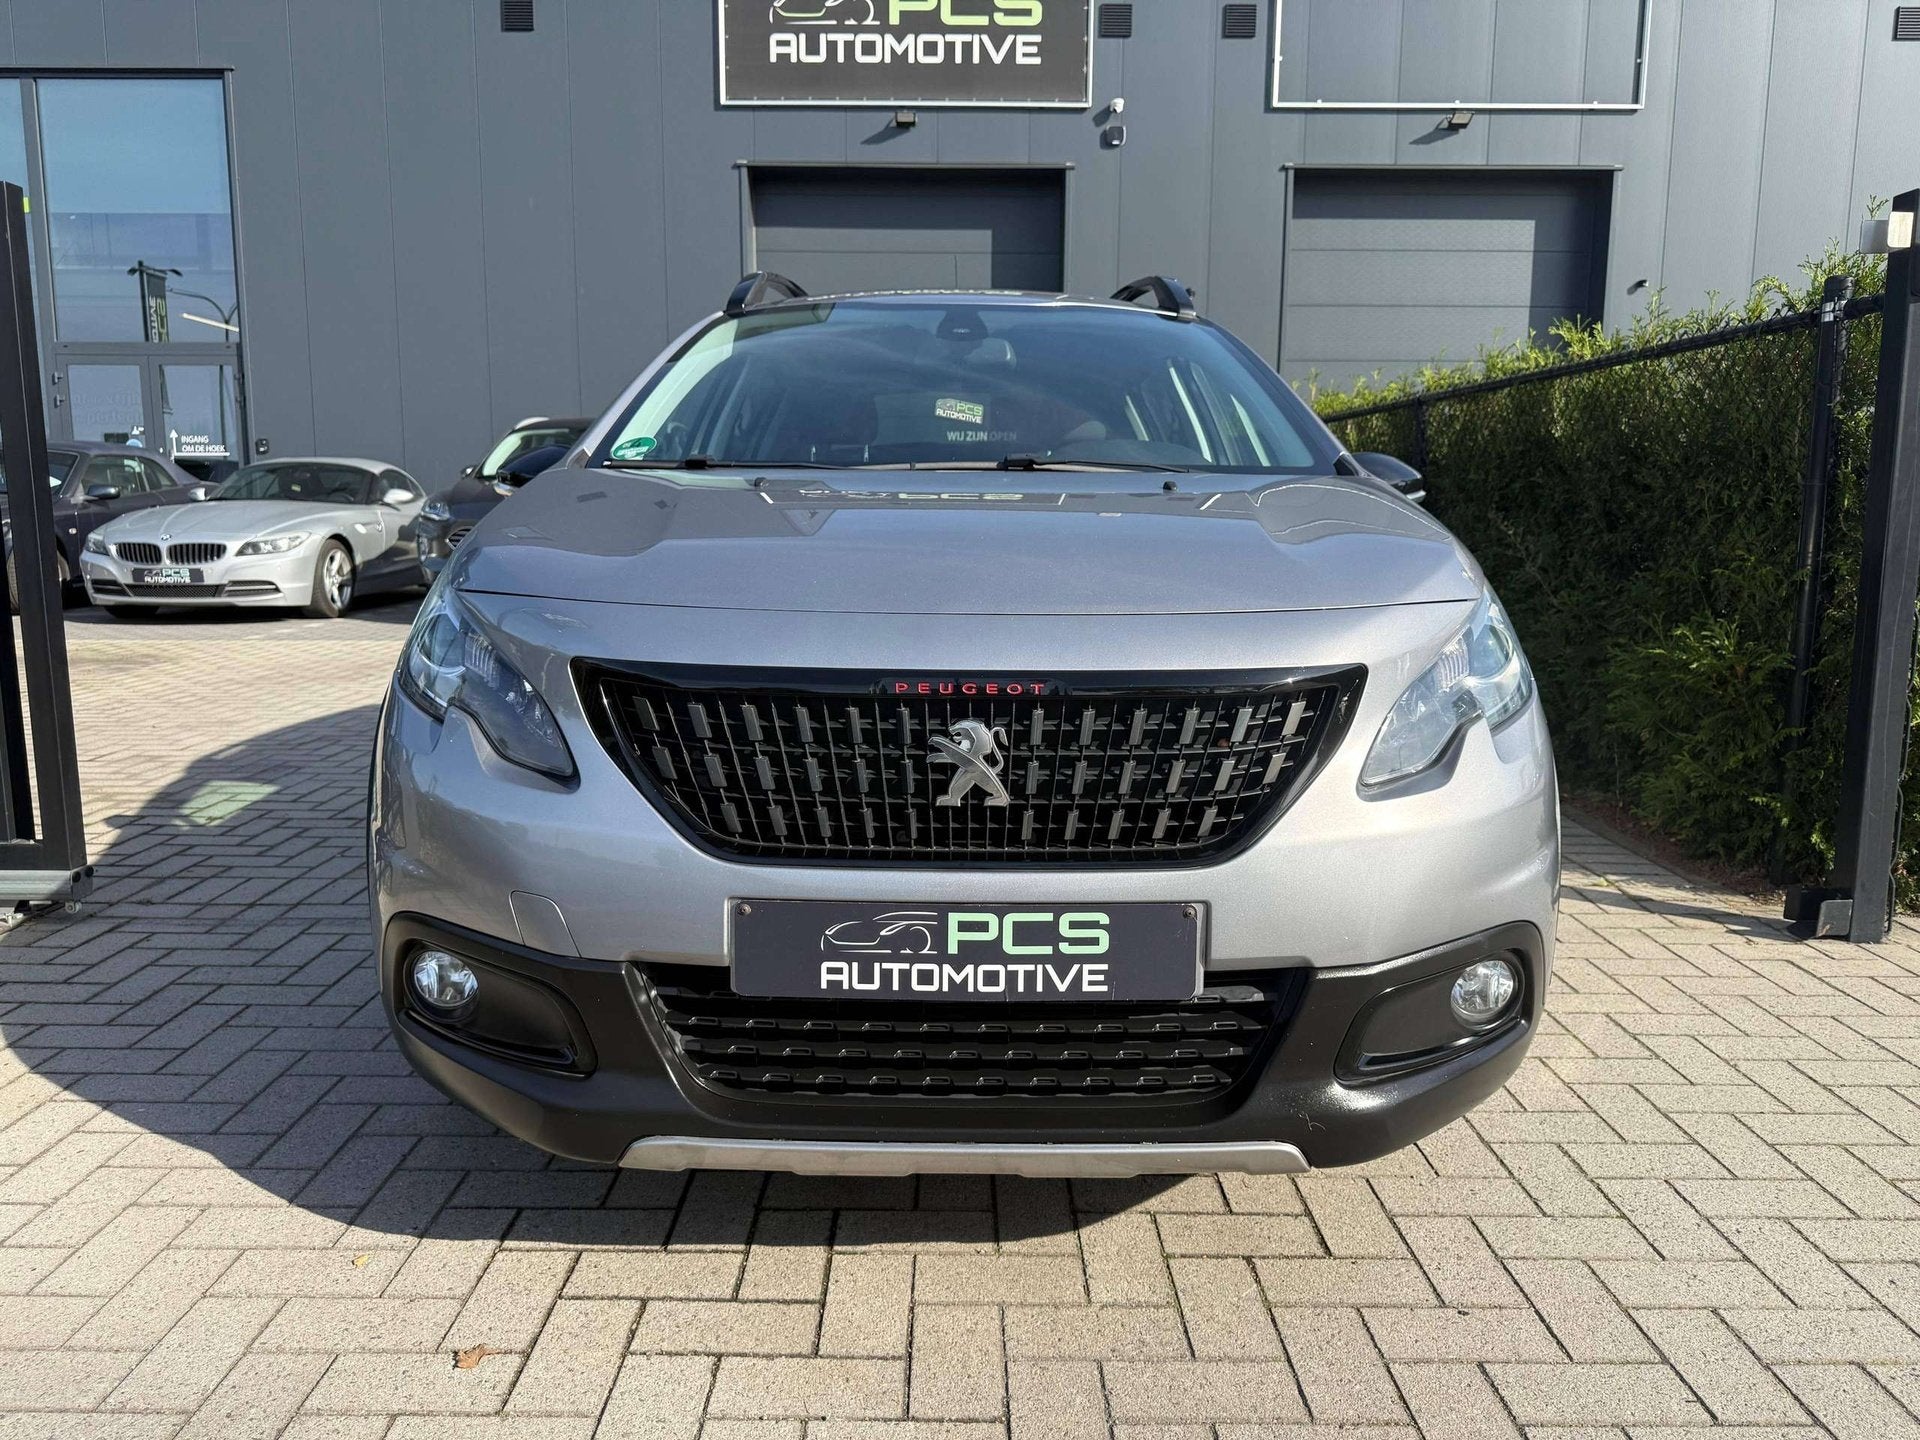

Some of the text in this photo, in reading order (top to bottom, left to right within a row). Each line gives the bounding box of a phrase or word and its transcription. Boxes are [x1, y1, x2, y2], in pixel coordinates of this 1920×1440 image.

[888, 0, 1043, 26] PCS
[769, 33, 1042, 64] AUTOMOTIVE
[936, 408, 983, 424] AUTOMOTIVE
[956, 403, 982, 416] PCS
[181, 435, 209, 444] INGANG
[162, 568, 190, 577] PCS
[144, 576, 191, 584] AUTOMOTIVE
[895, 682, 1045, 695] PEUGEOT
[947, 911, 1110, 955] PCS
[820, 961, 1109, 993] AUTOMOTIVE
